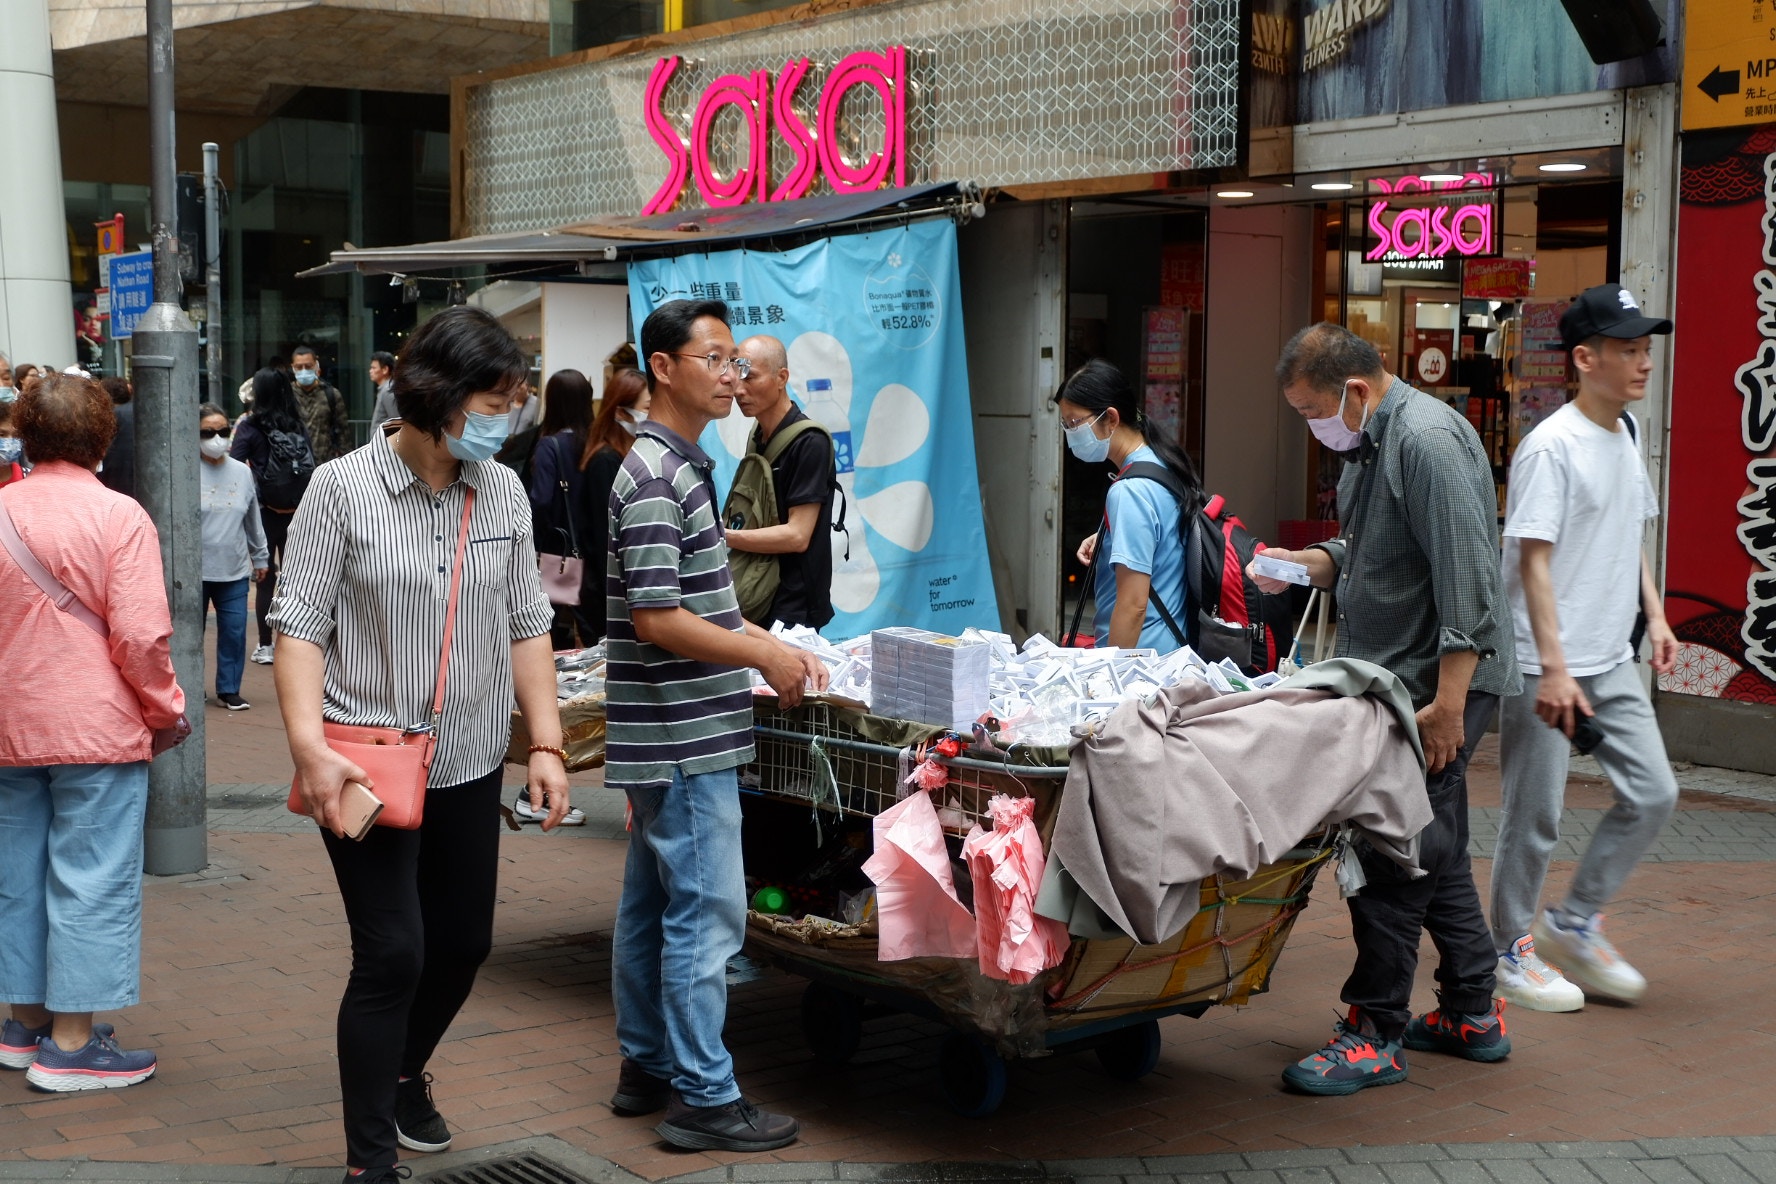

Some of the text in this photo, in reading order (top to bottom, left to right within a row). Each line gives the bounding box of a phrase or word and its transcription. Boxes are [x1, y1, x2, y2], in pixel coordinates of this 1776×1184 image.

[1303, 34, 1345, 73] FITNESS
[117, 263, 135, 274] Subway
[136, 261, 143, 271] to
[117, 273, 149, 288] Nathan Road
[651, 281, 743, 303] 少一些重量
[929, 589, 941, 602] for
[931, 598, 975, 612] tomorrow
